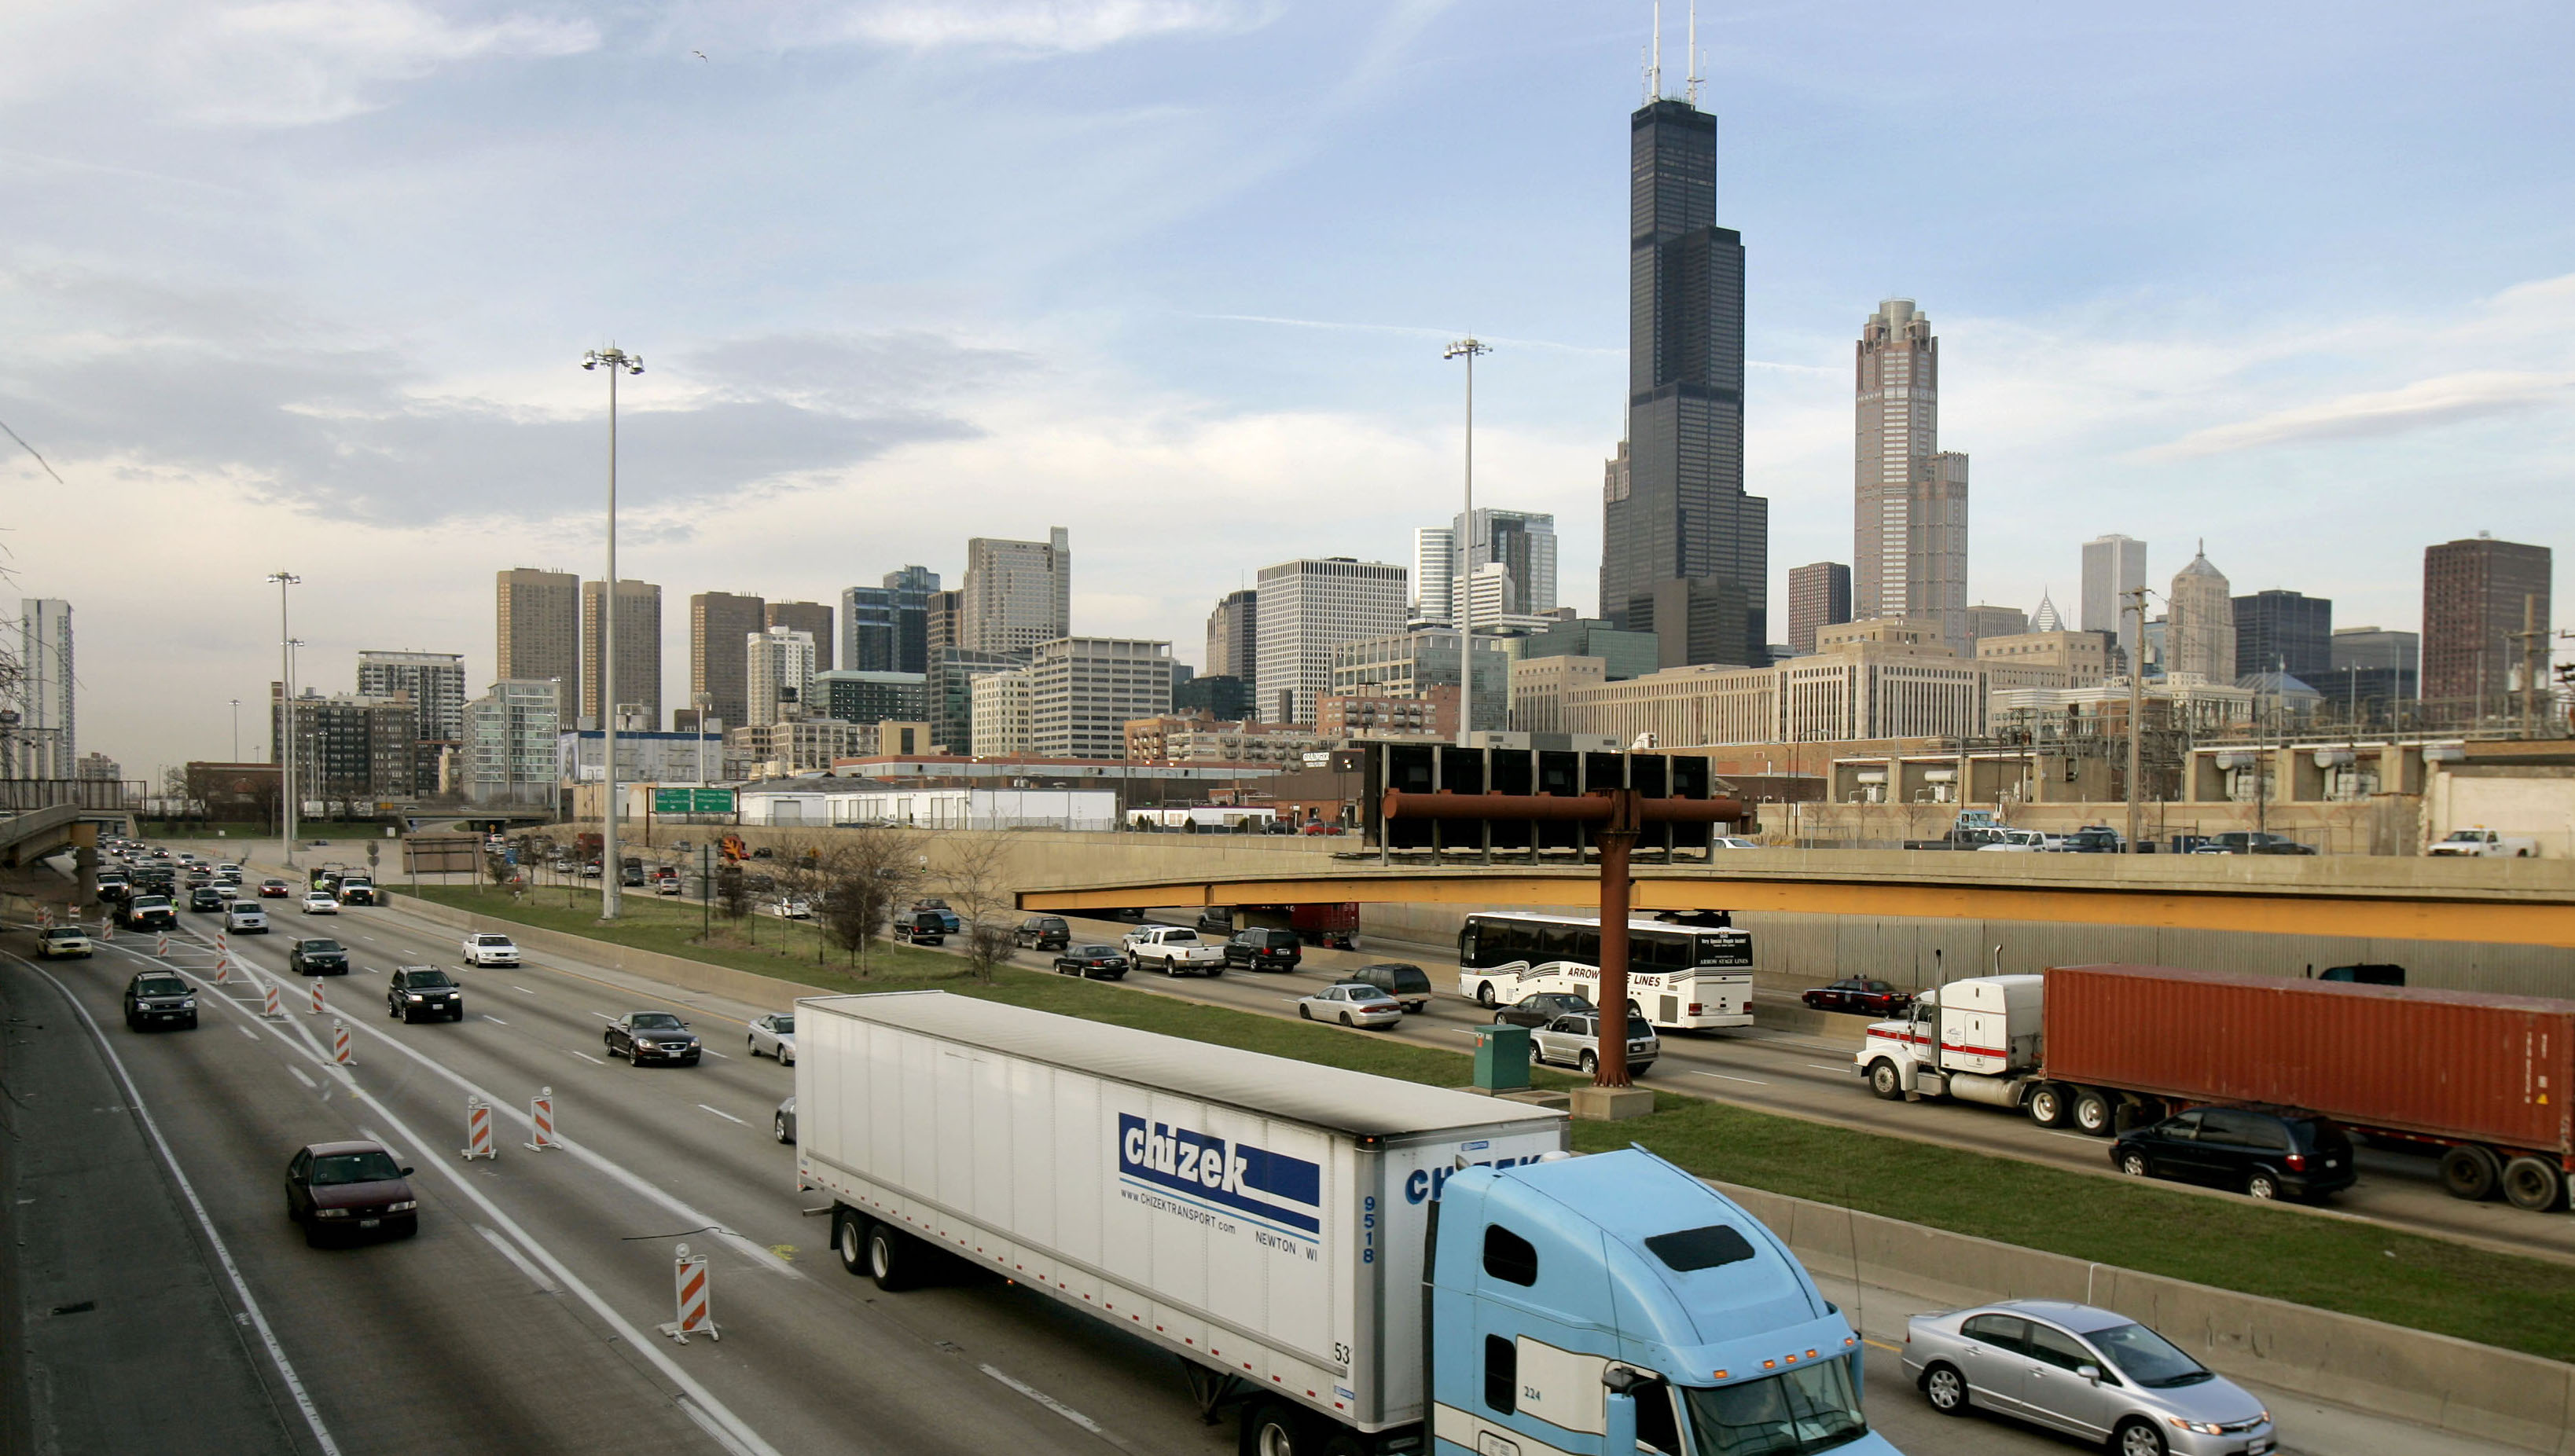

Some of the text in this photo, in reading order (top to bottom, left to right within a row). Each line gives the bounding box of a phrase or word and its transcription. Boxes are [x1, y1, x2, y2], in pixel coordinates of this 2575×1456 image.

[1567, 967, 1600, 980] ARROW
[1634, 974, 1661, 987] LINES
[1125, 1118, 1248, 1194] chizek
[1255, 1230, 1317, 1262] NEWTON WI
[1523, 1385, 1541, 1402] 224
